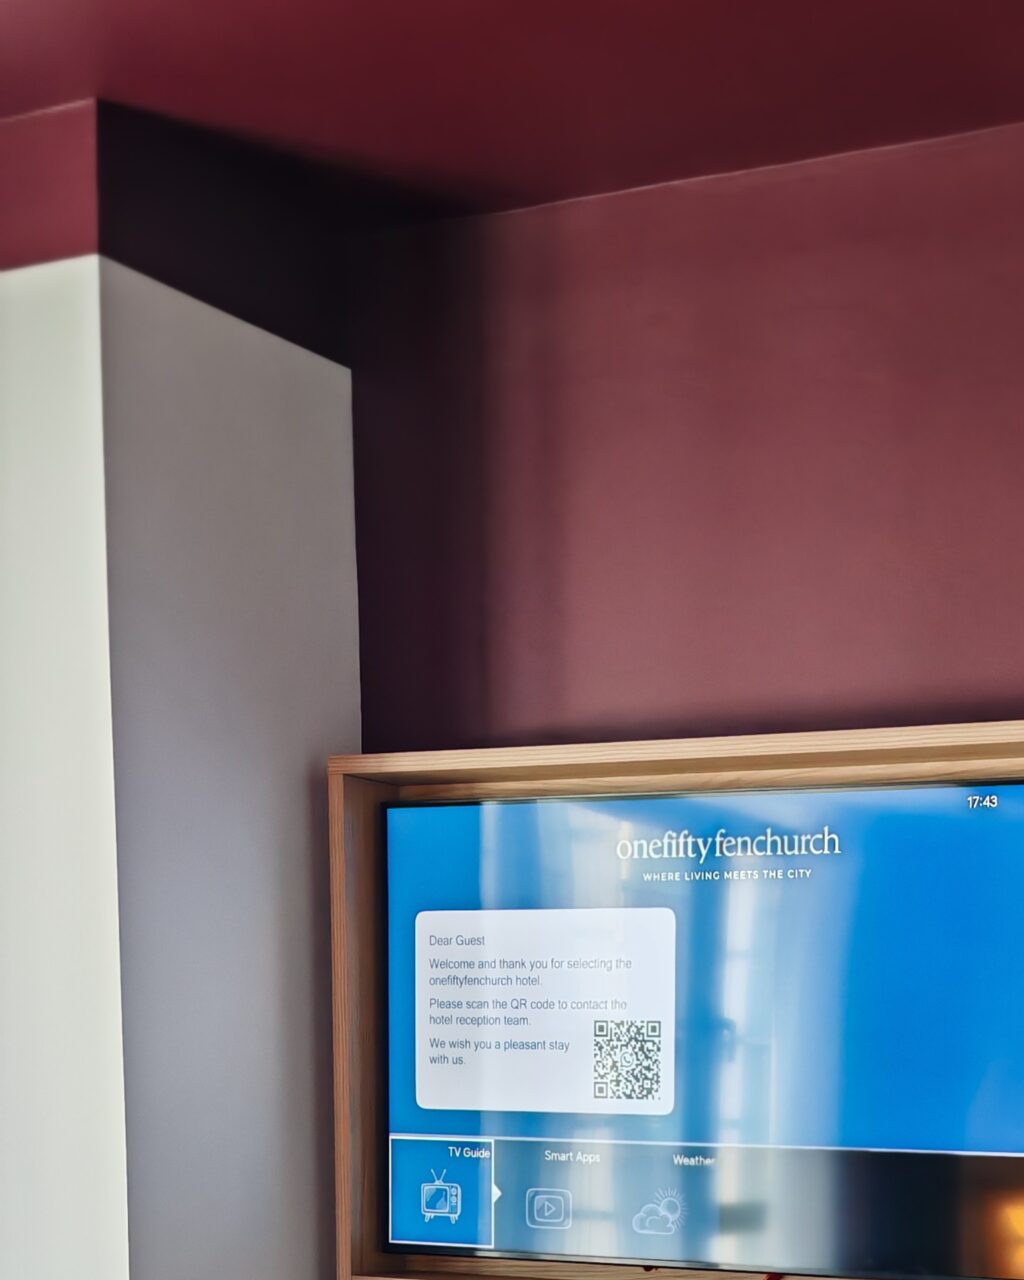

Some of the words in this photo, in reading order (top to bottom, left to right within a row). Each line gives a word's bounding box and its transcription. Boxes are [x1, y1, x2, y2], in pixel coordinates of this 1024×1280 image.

[967, 795, 998, 809] 17:43
[642, 871, 681, 882] WHERE
[684, 870, 720, 881] LIVING
[723, 869, 759, 880] MEETS
[763, 869, 784, 879] THE
[787, 868, 813, 879] CITY
[429, 934, 453, 946] Dear
[455, 934, 486, 947] Guest
[429, 958, 476, 969] Welcome
[477, 958, 497, 969] and
[499, 958, 527, 969] thank
[529, 960, 548, 973] you
[550, 958, 565, 969] for
[567, 958, 613, 972] selecting
[615, 958, 633, 969] the
[429, 975, 513, 989] onefiftyfenchurch
[515, 975, 543, 986] hotel.
[429, 998, 464, 1009] Please
[465, 1000, 489, 1009] scan
[492, 998, 508, 1009] the
[510, 999, 528, 1010] QR
[530, 999, 556, 1010] code
[557, 1000, 568, 1010] to
[570, 1000, 608, 1010] contact
[429, 1015, 453, 1026] hotel
[455, 1015, 501, 1028] reception
[503, 1016, 532, 1026] team.
[429, 1038, 446, 1049] We
[448, 1038, 471, 1049] wish
[473, 1040, 492, 1053] you
[494, 1041, 501, 1050] a
[503, 1039, 546, 1053] pleasant
[549, 1040, 570, 1053] stay
[429, 1054, 450, 1065] with
[451, 1056, 467, 1065] us.
[448, 1146, 462, 1157] TV
[463, 1147, 491, 1159] Guide
[544, 1150, 573, 1162] Smart
[576, 1151, 601, 1165] Apps
[673, 1154, 716, 1166] Weather
